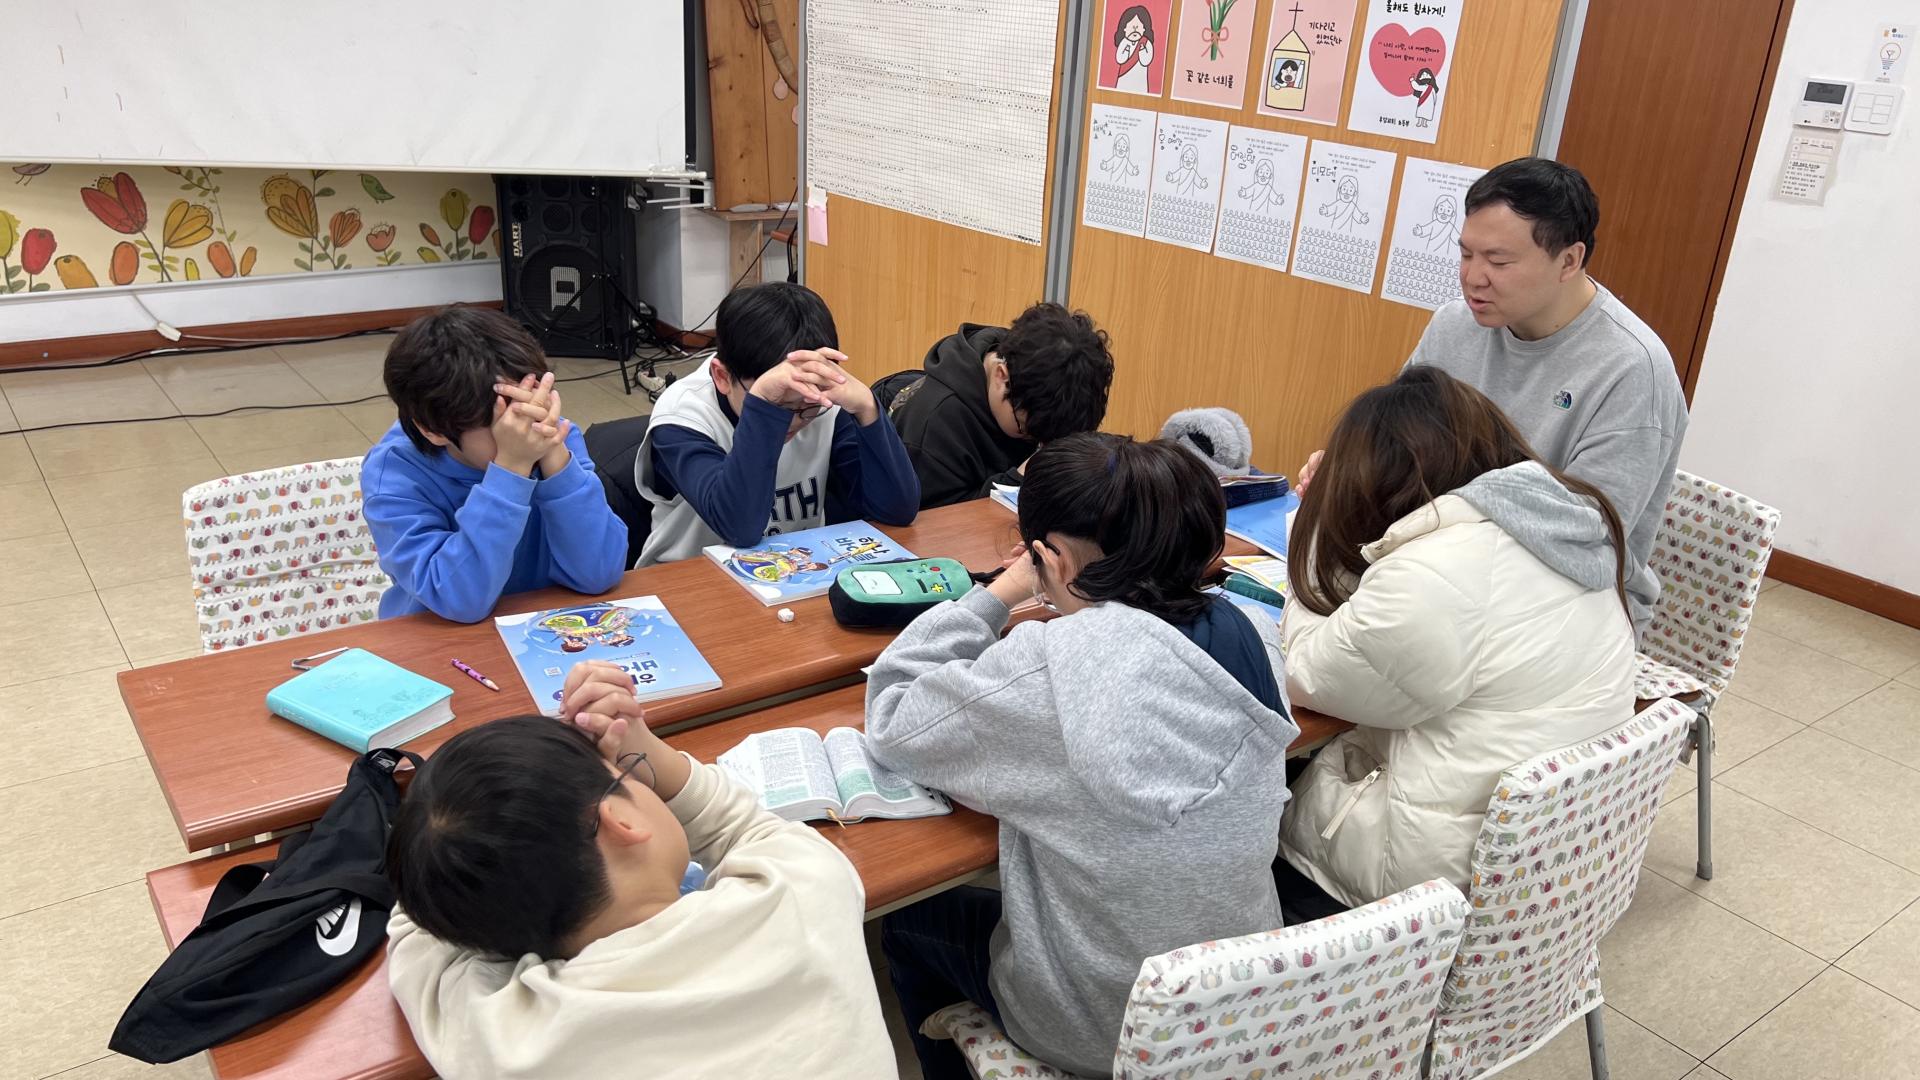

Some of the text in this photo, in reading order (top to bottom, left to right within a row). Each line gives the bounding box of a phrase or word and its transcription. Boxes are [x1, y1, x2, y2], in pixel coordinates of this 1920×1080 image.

[1386, 0, 1446, 18] 올해도 힘차게!
[1309, 21, 1336, 32] 기다리고
[1316, 34, 1343, 47] 있었단다
[1186, 69, 1234, 89] 꽃 같은 너희를
[511, 222, 520, 257] DART
[770, 476, 819, 521] TH
